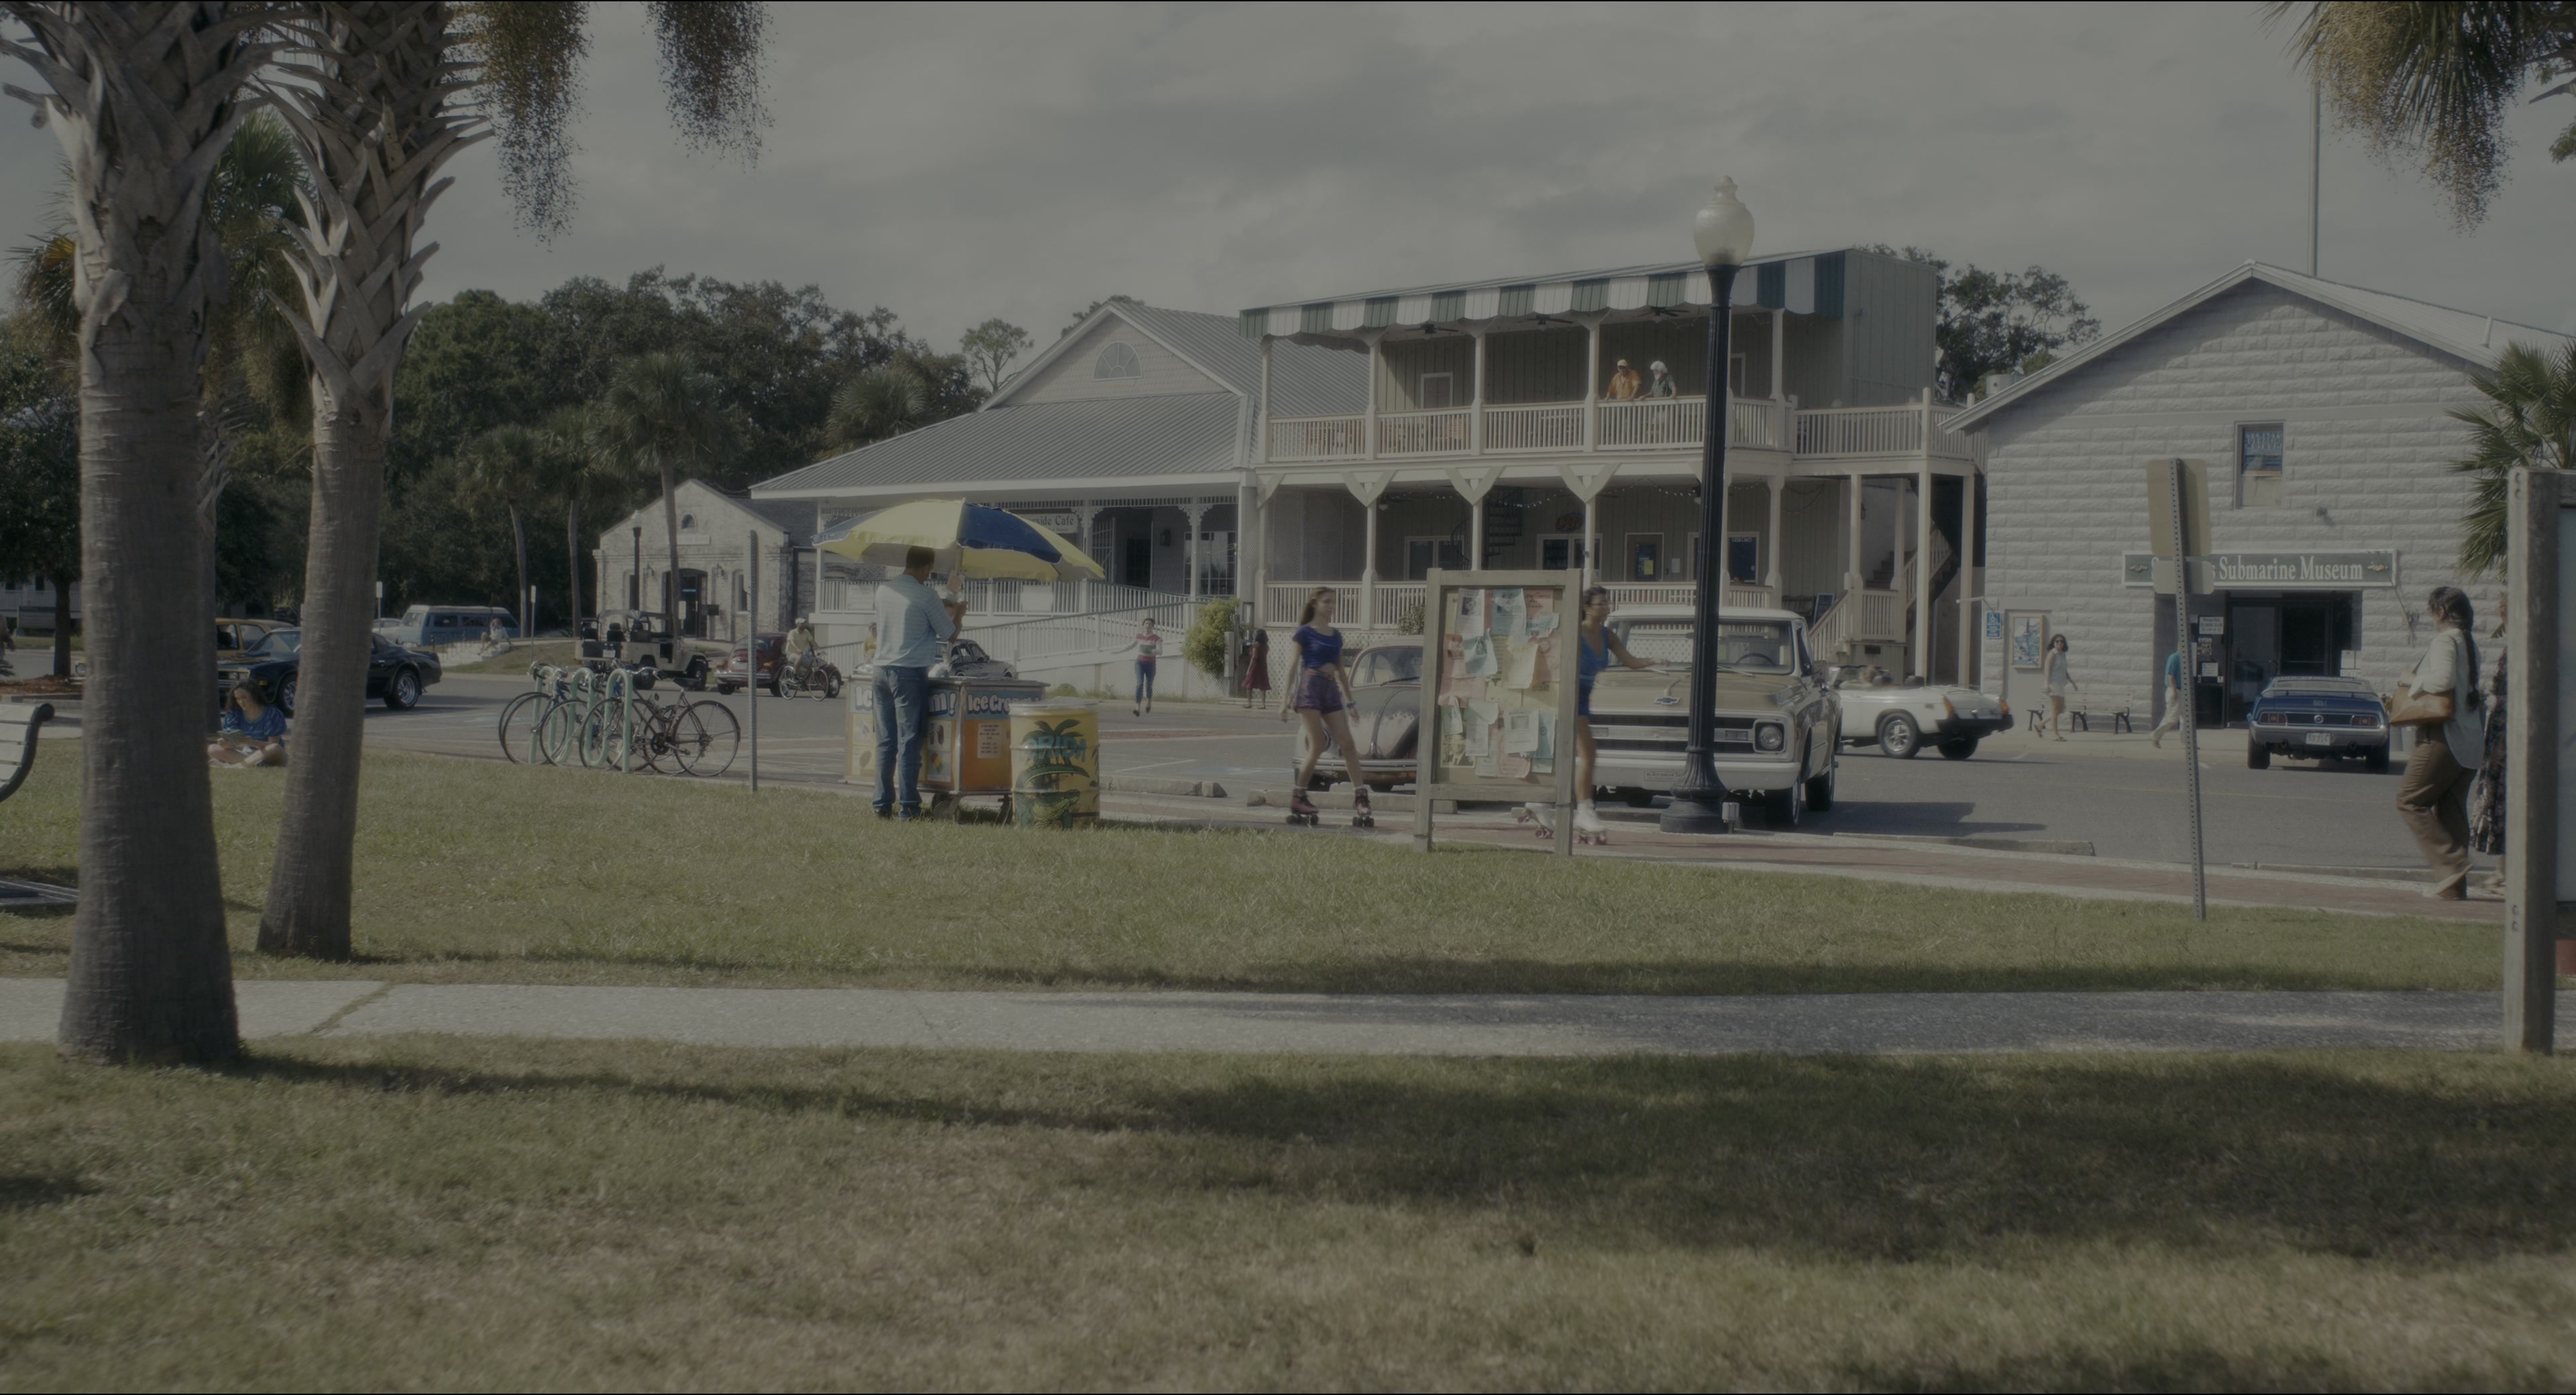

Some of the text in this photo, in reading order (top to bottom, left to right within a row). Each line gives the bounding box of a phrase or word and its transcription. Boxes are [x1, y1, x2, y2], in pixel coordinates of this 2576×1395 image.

[1556, 515, 1580, 529] OPEN
[2219, 556, 2296, 579] Submarine
[2300, 556, 2363, 579] Museum
[855, 685, 872, 710] Ic
[967, 693, 989, 712] Ice
[1022, 735, 1086, 763] ORIDA
